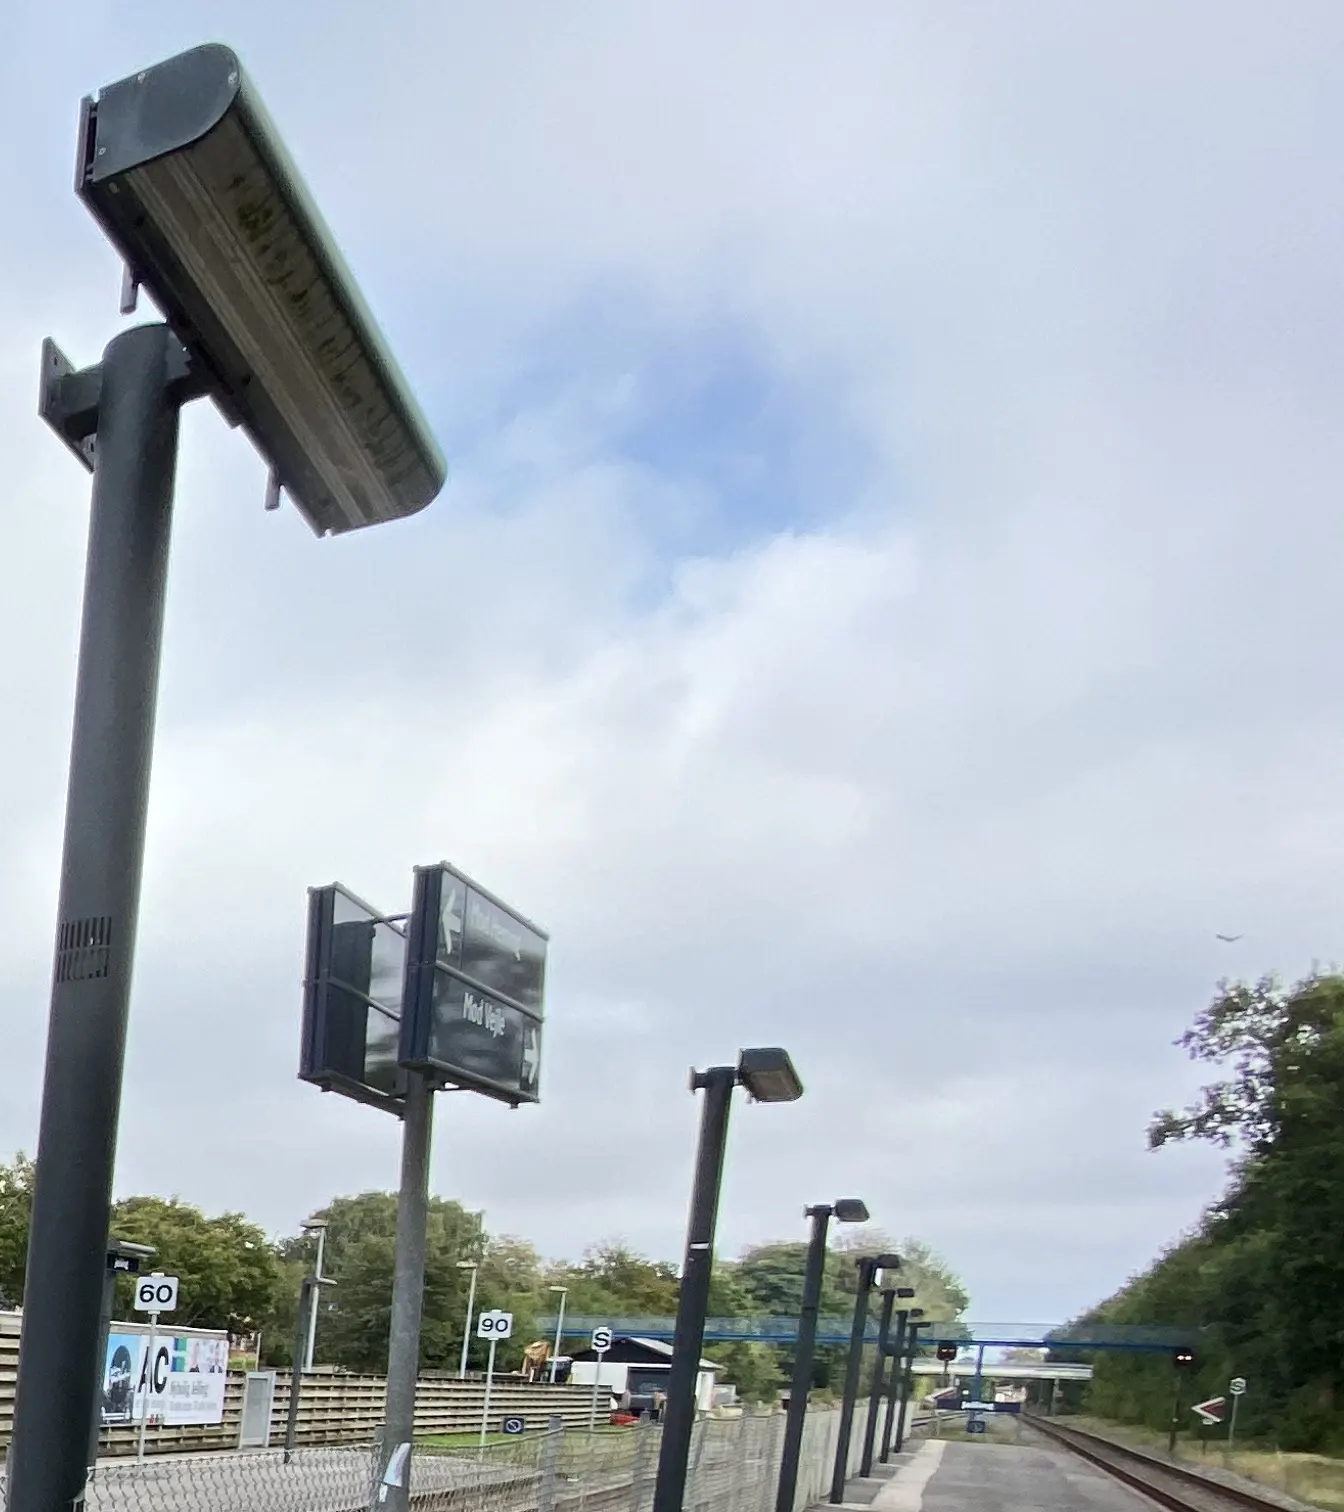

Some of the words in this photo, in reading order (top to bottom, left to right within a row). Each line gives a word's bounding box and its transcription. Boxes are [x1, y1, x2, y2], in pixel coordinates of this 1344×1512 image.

[463, 991, 483, 1025] Mod
[140, 1285, 173, 1303] 60
[481, 1318, 509, 1332] 90
[593, 1332, 610, 1348] S
[1231, 1381, 1245, 1392] S
